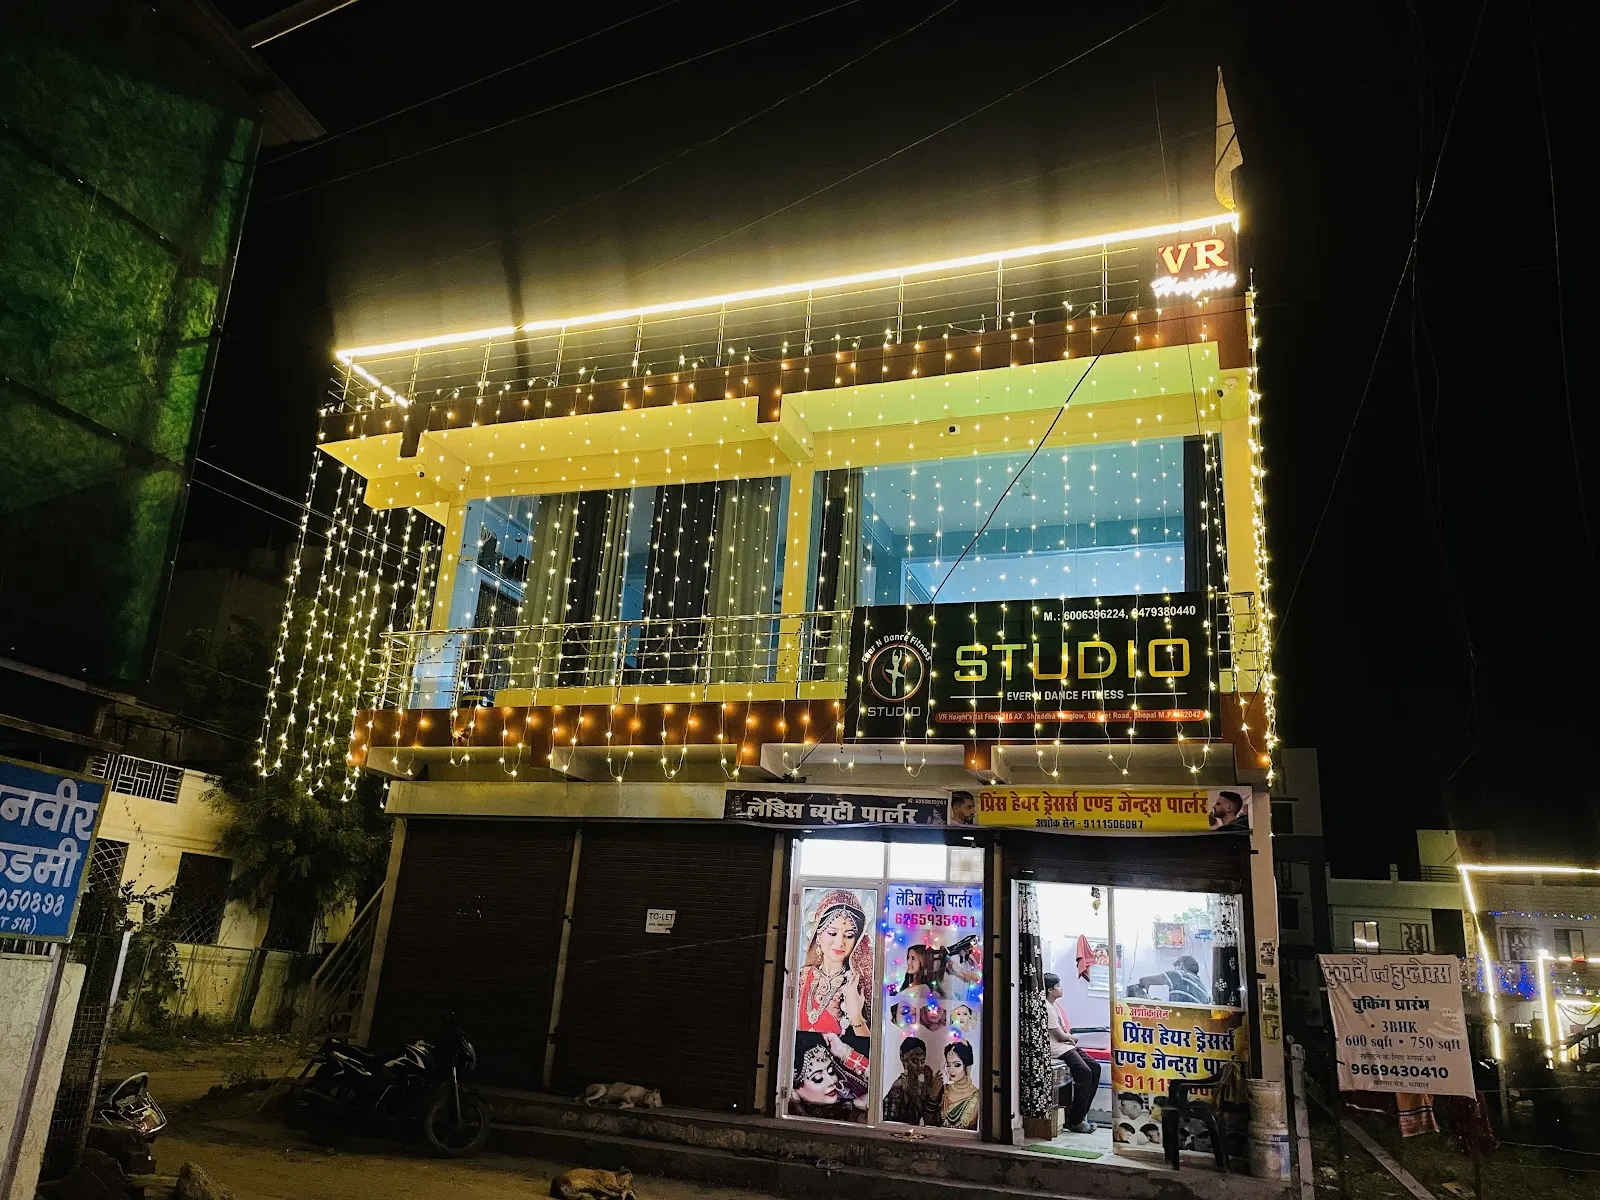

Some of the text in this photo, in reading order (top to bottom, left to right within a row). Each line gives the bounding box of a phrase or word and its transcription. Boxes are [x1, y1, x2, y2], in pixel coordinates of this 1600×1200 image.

[1158, 238, 1229, 274] VR
[861, 645, 877, 663] Eer
[883, 634, 909, 643] Dance
[909, 636, 933, 662] Fitness
[953, 638, 1191, 682] STUDIO
[1006, 691, 1032, 701] EVER
[1044, 691, 1079, 700] DANCE
[1081, 689, 1125, 700] FITNESS
[867, 706, 921, 717] STUDIO
[746, 797, 919, 825] लेडिस ब्यूटी पार्लर
[980, 790, 1008, 812] प्रिंस
[1082, 796, 1114, 813] एण्ड
[1166, 791, 1209, 814] पार्लर
[1035, 816, 1061, 828] अशोक
[1062, 816, 1075, 828] सेन
[1083, 819, 1143, 829] 9111506087
[895, 888, 974, 912] लेडिस ब्यूटी पार्लर
[649, 912, 675, 921] TO-LET
[1129, 1005, 1155, 1018] अशोक
[1155, 1007, 1170, 1019] सेन
[1352, 995, 1430, 1013] बुकिंग प्रारंभ
[1122, 1021, 1154, 1045] प्रिंस
[1157, 1023, 1191, 1048] हेयर
[1381, 1021, 1418, 1034] 3BHK
[1345, 1034, 1461, 1051] 600 sqft 750 sqft
[1114, 1049, 1147, 1069] एण्ड
[1351, 1063, 1449, 1079] 9669430410
